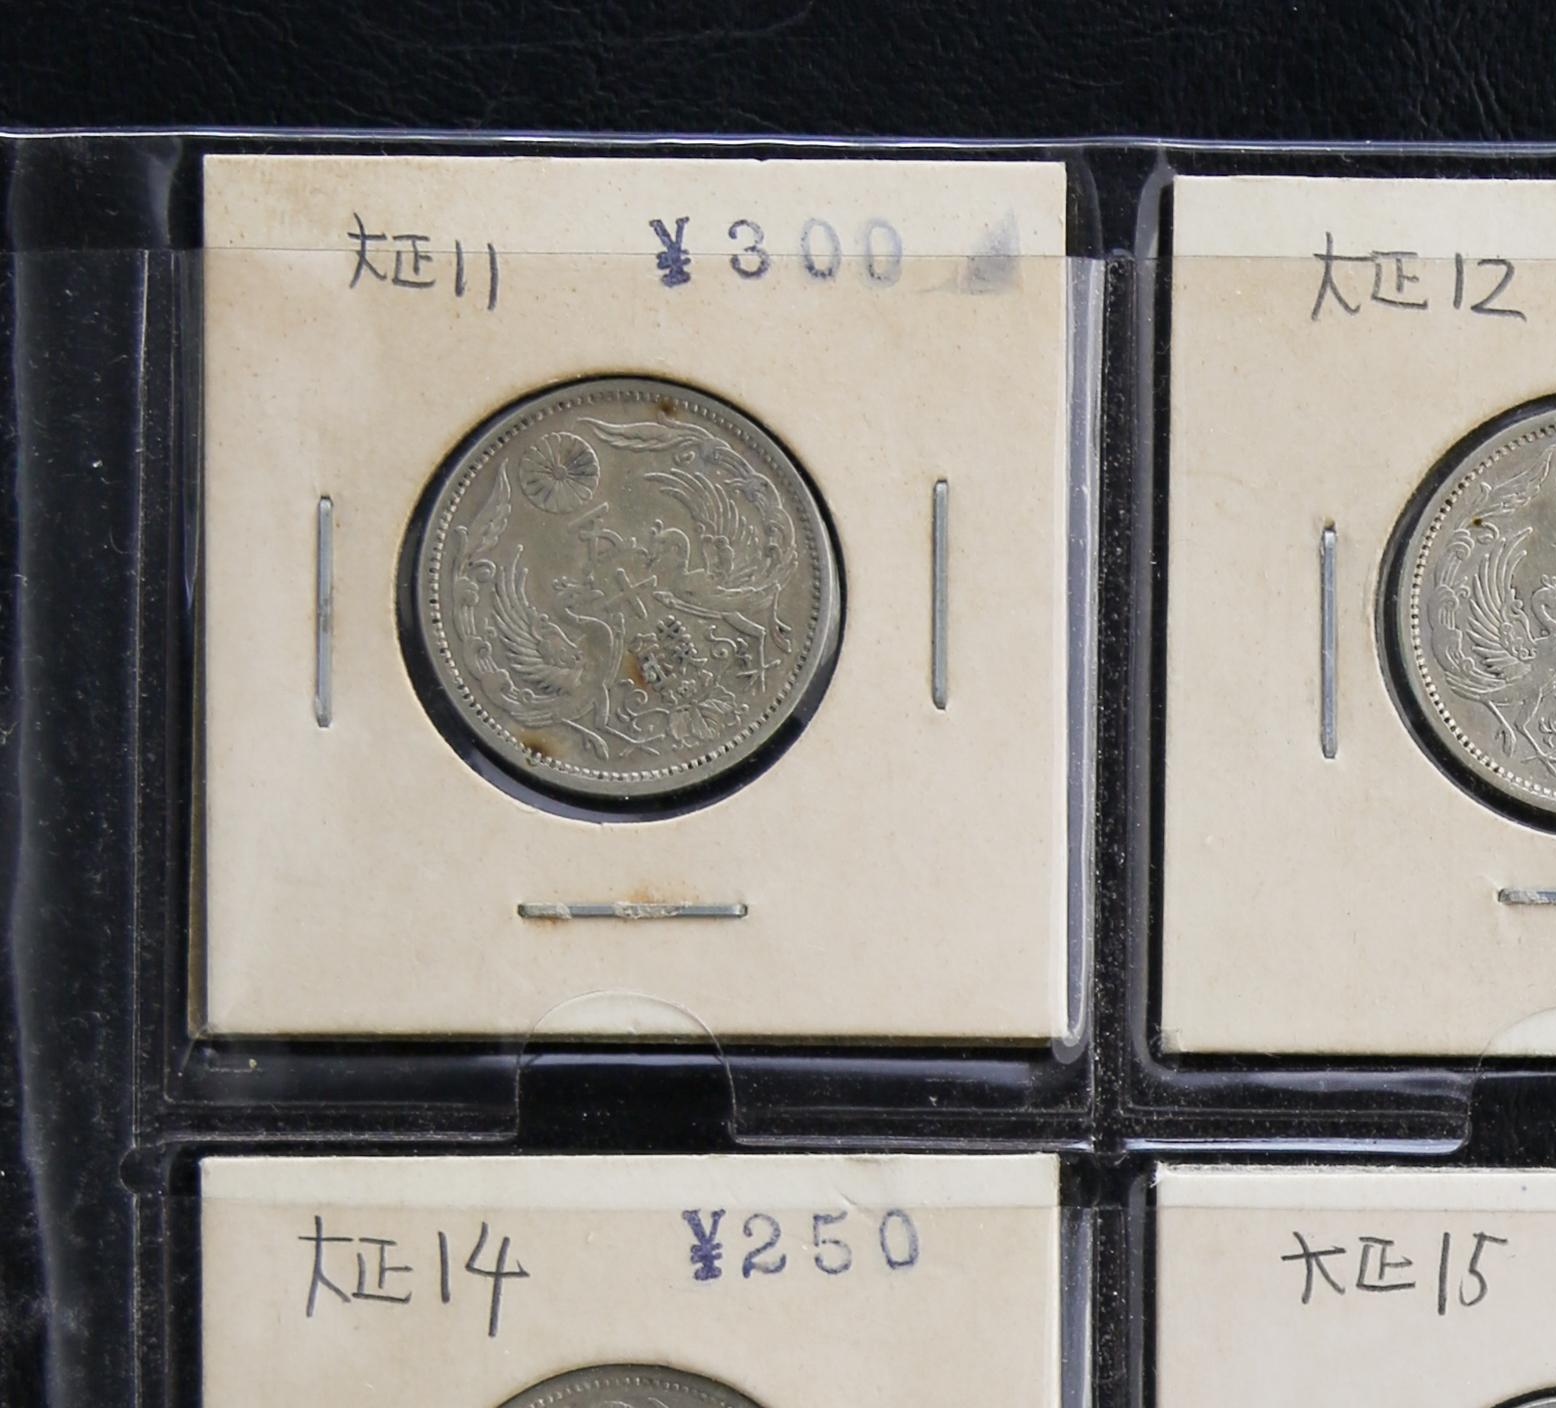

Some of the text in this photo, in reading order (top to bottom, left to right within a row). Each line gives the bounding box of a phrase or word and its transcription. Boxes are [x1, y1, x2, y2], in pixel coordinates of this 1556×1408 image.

[1311, 232, 1527, 321] 大正12
[298, 1215, 530, 1338] 大正14
[682, 1208, 919, 1281] ¥250
[1281, 1232, 1507, 1315] 大正15
